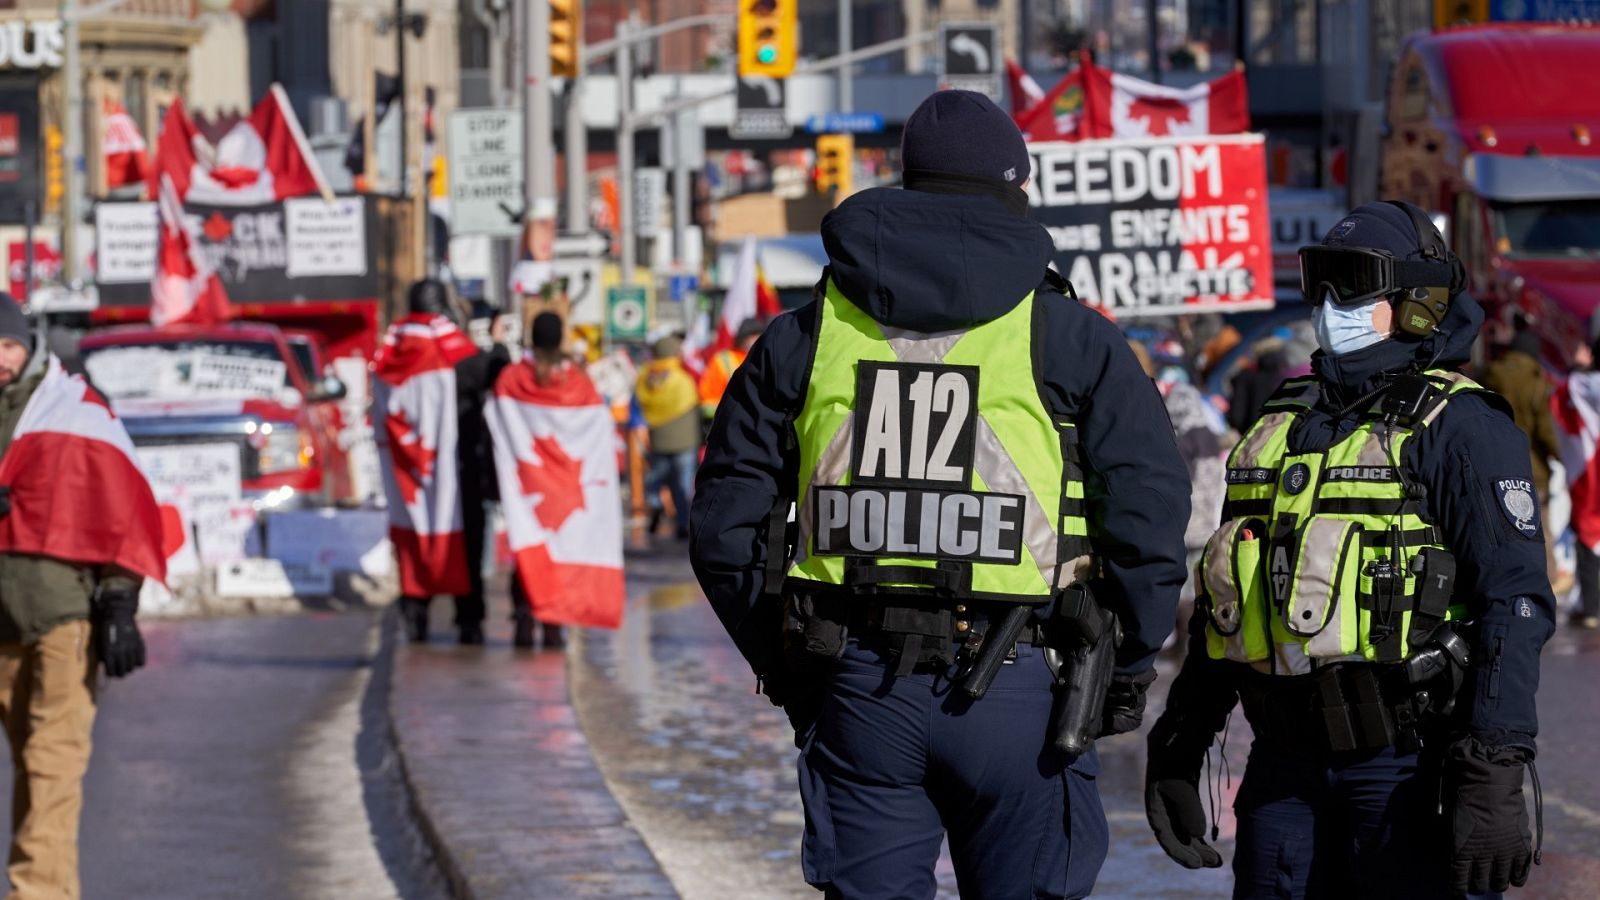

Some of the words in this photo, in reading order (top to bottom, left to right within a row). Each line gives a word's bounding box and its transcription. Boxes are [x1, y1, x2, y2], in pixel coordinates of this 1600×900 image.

[467, 117, 507, 134] STOP
[470, 138, 506, 152] LINE
[465, 163, 512, 178] LIGNE
[1028, 144, 1222, 207] REEDOM
[1111, 204, 1250, 248] ENFANTS
[1275, 217, 1324, 243] UL
[859, 369, 970, 482] A12
[1329, 468, 1391, 480] POLICE
[1499, 480, 1531, 492] POLICE
[818, 490, 1018, 559] POLICE
[1436, 574, 1449, 589] T
